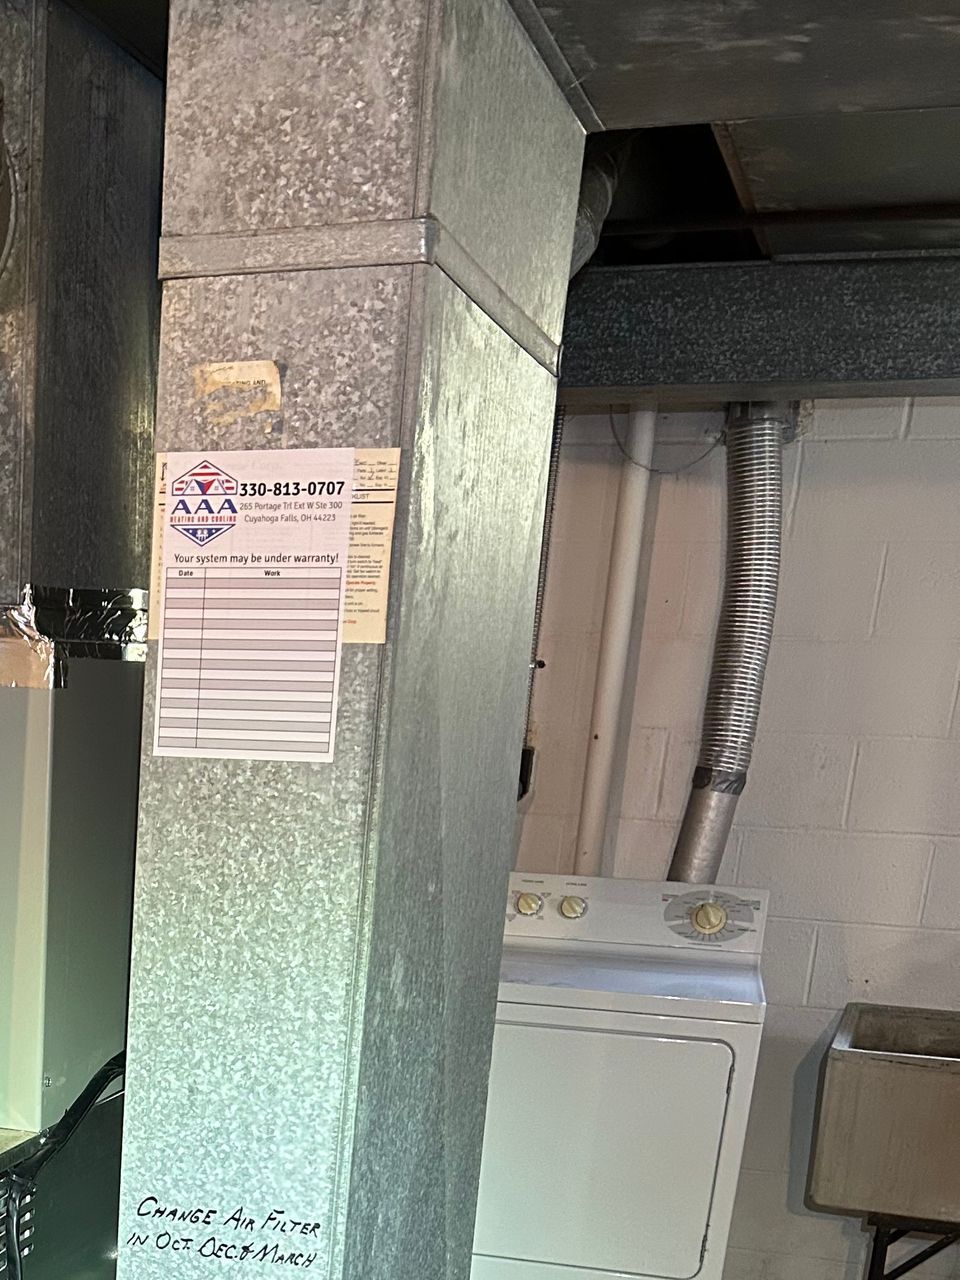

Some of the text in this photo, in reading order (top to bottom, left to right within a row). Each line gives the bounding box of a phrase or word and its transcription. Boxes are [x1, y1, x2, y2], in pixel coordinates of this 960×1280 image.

[239, 481, 345, 496] 330-813-0707
[171, 499, 238, 514] AAA
[255, 502, 281, 512] Portage
[284, 502, 292, 510] Trl
[294, 502, 305, 510] Ext
[244, 515, 278, 524] Cuyahoga
[280, 514, 299, 522] Falls,
[301, 514, 312, 522] OH
[174, 553, 338, 565] Your system may be under warranty!
[137, 1196, 320, 1238] CHANGE AIR FILTER
[126, 1232, 150, 1246] IN
[252, 1244, 318, 1268] MARCH
